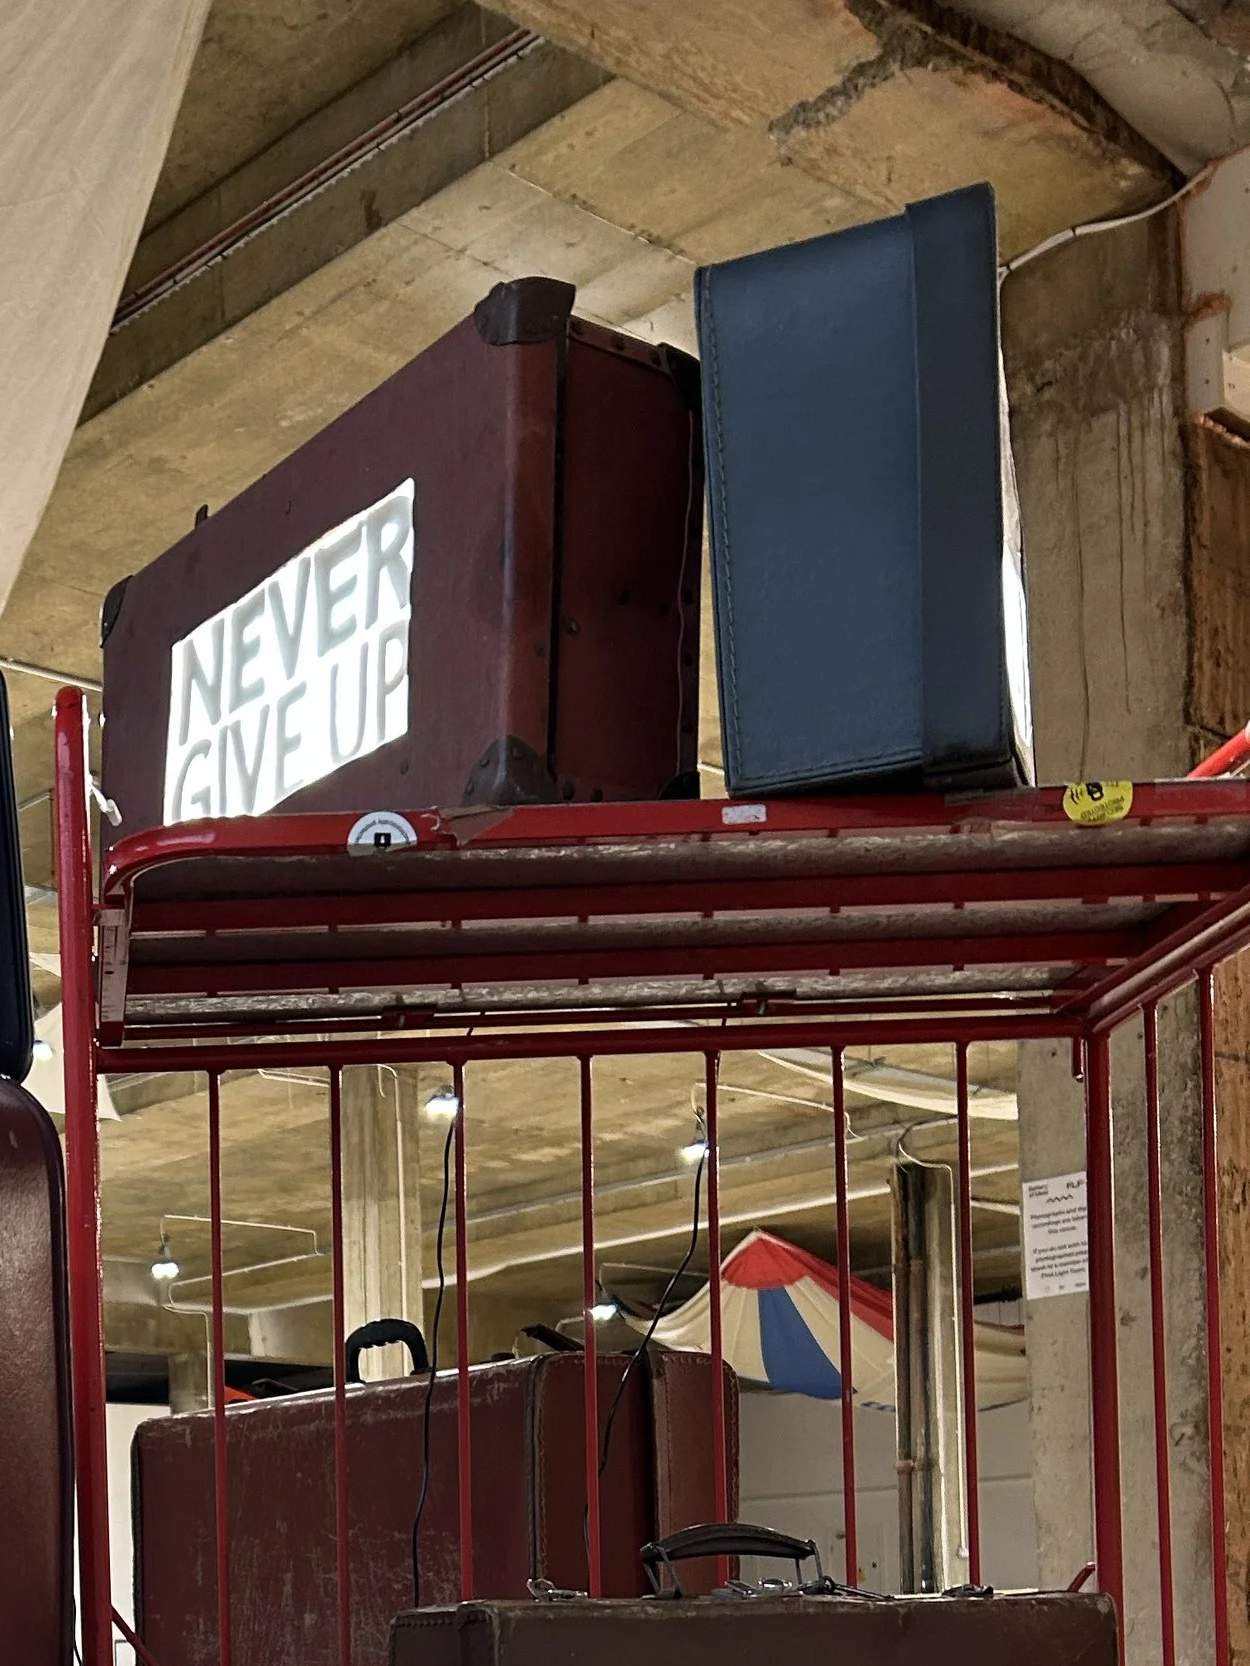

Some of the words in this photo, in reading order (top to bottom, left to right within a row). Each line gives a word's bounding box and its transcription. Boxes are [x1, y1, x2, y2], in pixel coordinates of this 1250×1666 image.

[171, 680, 306, 822] GIVE
[330, 618, 407, 766] UP
[178, 494, 409, 746] NEVER
